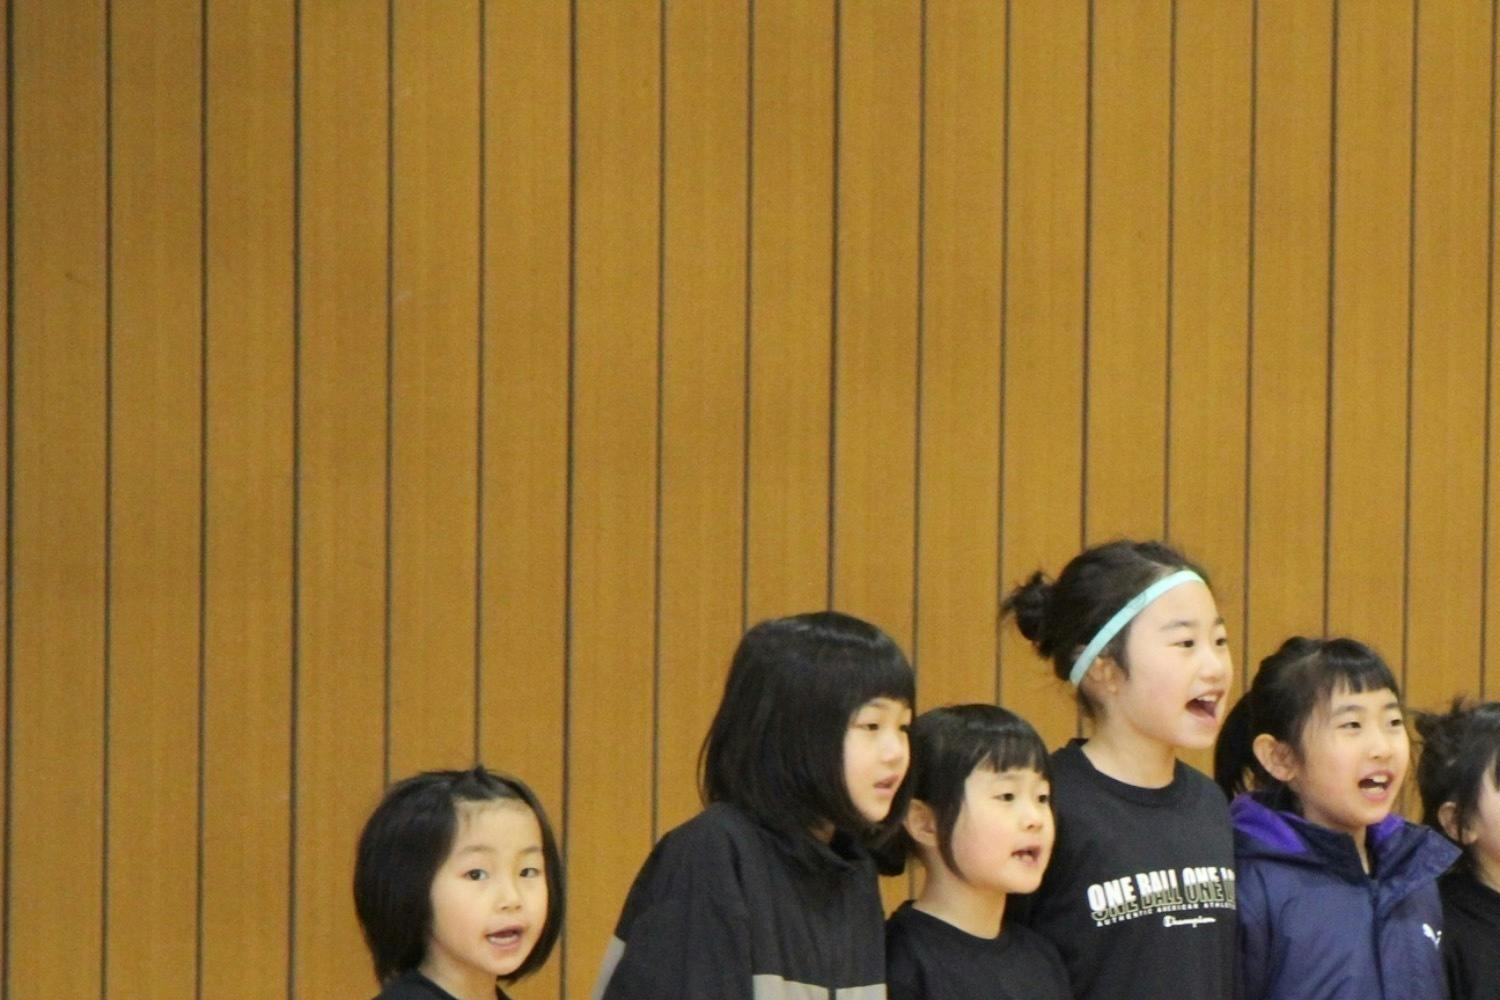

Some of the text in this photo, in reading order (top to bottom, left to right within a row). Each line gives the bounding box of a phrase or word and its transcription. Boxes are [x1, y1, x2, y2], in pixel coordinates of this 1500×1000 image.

[1087, 876, 1139, 919] ONE
[1136, 869, 1182, 908] BALL
[1183, 867, 1225, 904] ONE
